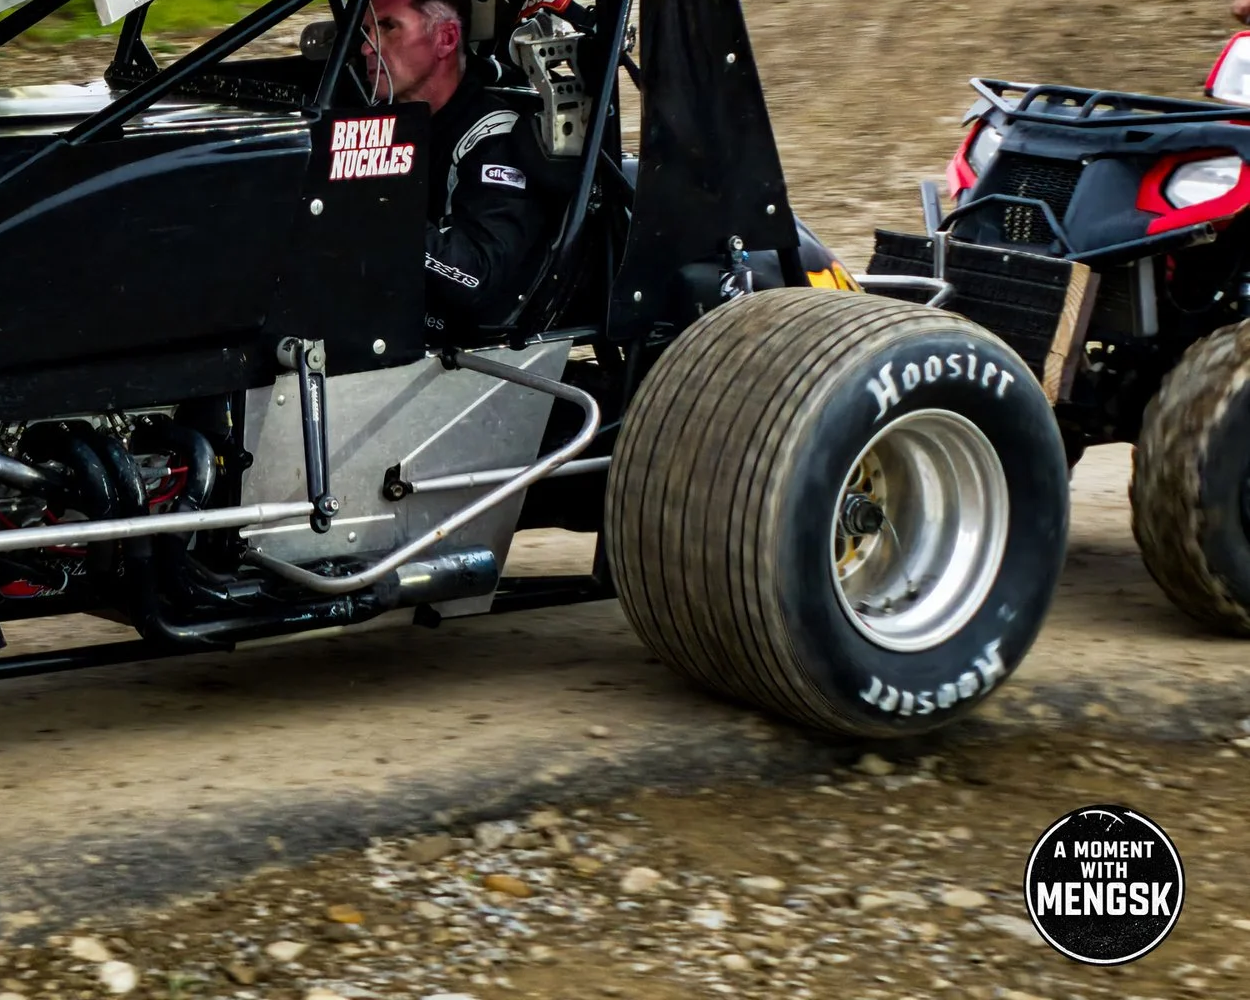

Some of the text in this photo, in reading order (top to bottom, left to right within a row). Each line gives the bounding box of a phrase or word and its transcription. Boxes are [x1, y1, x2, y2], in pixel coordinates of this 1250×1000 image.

[331, 116, 396, 150] BRYAN
[330, 144, 415, 180] NUCKLES
[866, 344, 1015, 422] Hoosier
